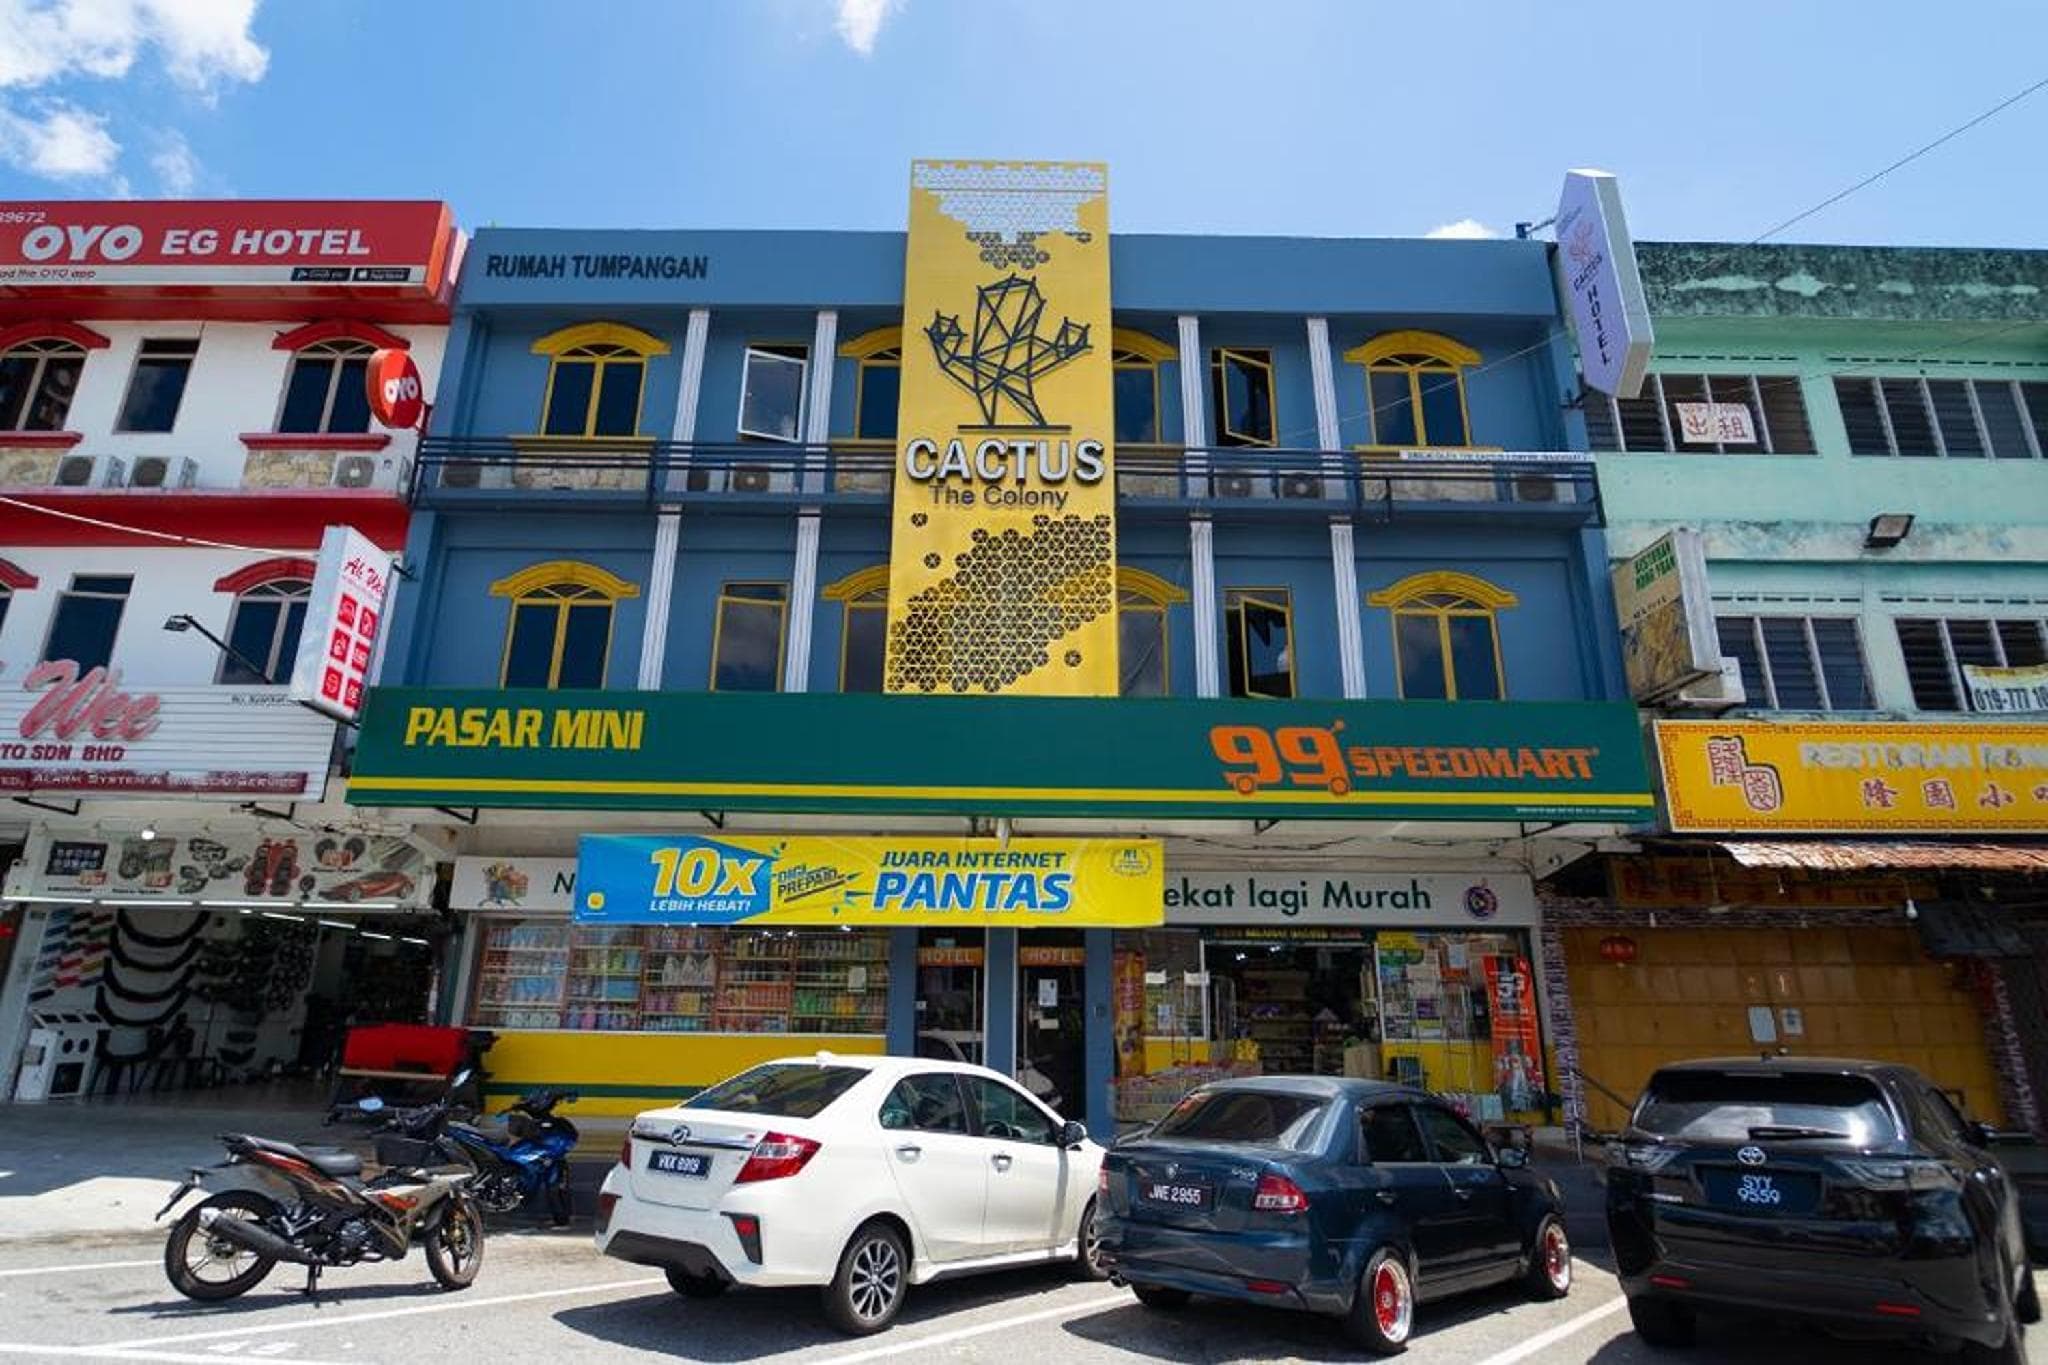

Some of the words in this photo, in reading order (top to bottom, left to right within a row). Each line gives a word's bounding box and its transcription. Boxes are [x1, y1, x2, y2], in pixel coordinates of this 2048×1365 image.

[22, 225, 143, 261] OYO
[161, 229, 218, 255] EG
[231, 229, 370, 255] HOTEL
[486, 254, 566, 278] RUMAH
[570, 254, 708, 279] TUMPANGAN
[1587, 284, 1611, 367] HOTEL
[384, 377, 419, 403] OYO
[905, 437, 1106, 483] CACTUS
[929, 484, 976, 506] The
[983, 485, 1069, 511] Colony
[20, 659, 161, 739] Wee
[1975, 688, 2031, 711] 019-777
[404, 707, 542, 748] PASAR
[551, 709, 644, 750] MINI
[30, 744, 72, 761] SDN
[81, 744, 126, 761] BHD
[1209, 719, 1351, 797] 99
[1350, 745, 1593, 780] SPEEDMART
[650, 847, 764, 898] 10x
[880, 850, 949, 869] JUARA
[955, 851, 1067, 869] INTERNET
[871, 871, 1074, 912] PANTAS
[1248, 878, 1309, 916] lagi
[1323, 878, 1432, 910] Murah
[650, 899, 695, 912] LEBIH
[697, 900, 752, 913] HEBAT!
[921, 948, 973, 963] HOTEL
[1027, 949, 1082, 964] HOTEL
[1149, 1184, 1170, 1202] JWE
[1742, 1174, 1773, 1190] SYY
